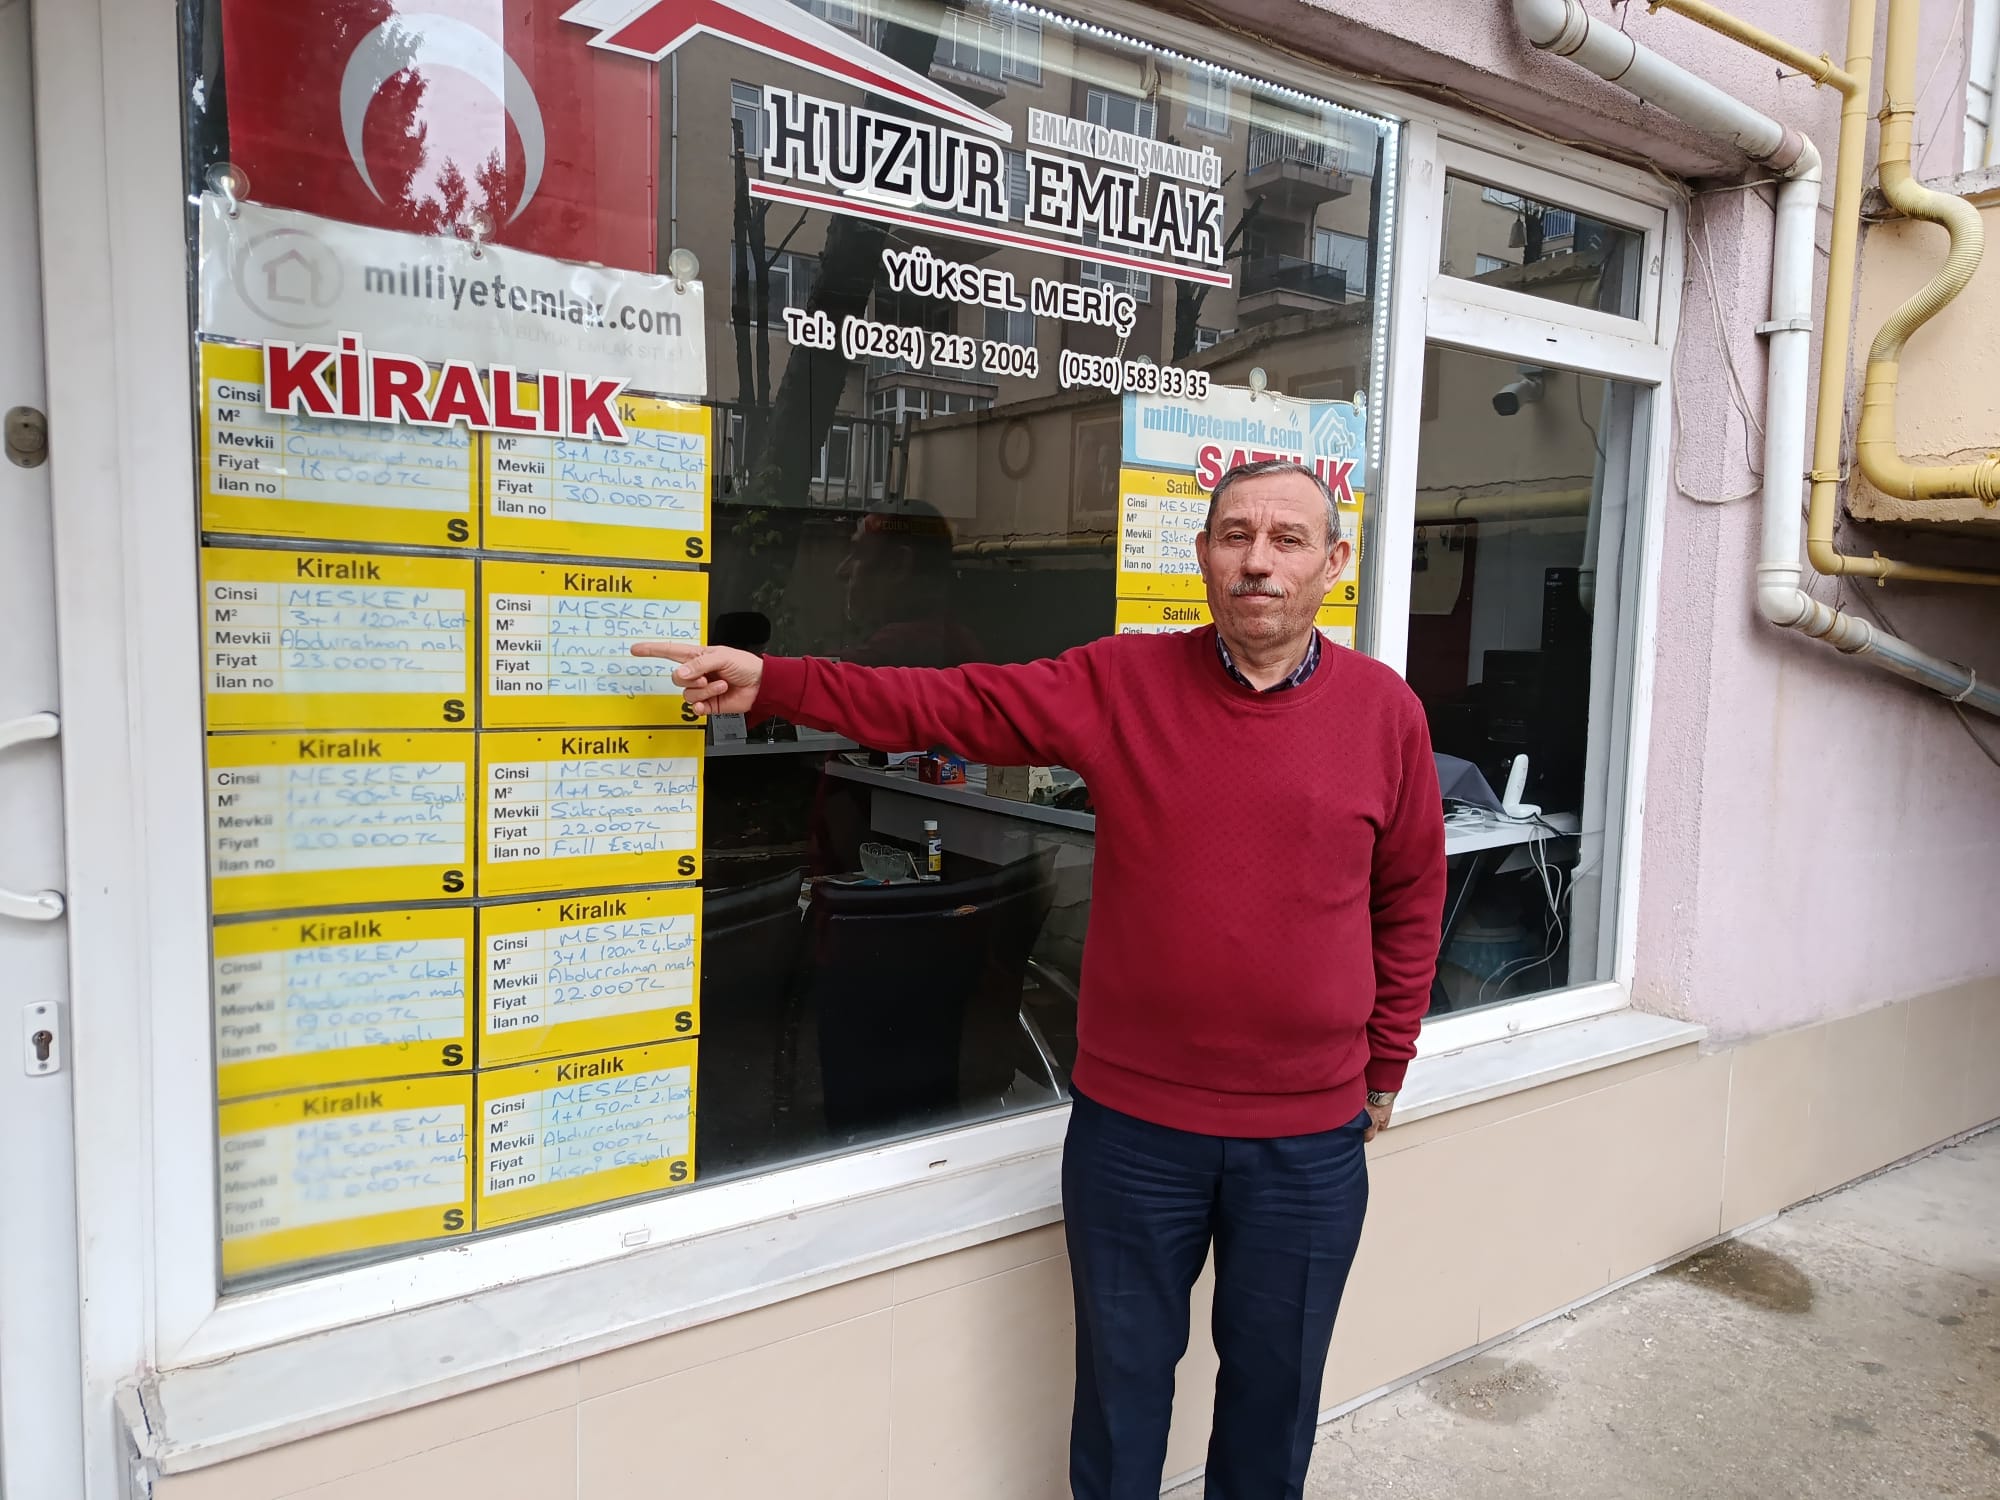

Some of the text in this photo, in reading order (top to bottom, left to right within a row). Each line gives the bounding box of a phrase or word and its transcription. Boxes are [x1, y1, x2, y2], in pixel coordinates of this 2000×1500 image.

[1032, 112, 1220, 185] EMLAK DANIŞMANLIĞI
[770, 93, 1219, 258] HUZUR EMLAK
[885, 252, 1135, 332] YÜKSEL MERİÇ
[365, 264, 683, 337] milliyetemlak.com
[788, 312, 1036, 374] Tel: (0284) 213 2004
[1063, 350, 1207, 396] (0530) 583 33 35
[217, 386, 261, 402] Cinsi
[268, 336, 621, 439] KİRALIK
[1143, 406, 1303, 449] milliyetemlak.com
[217, 432, 274, 449] Mevkii
[497, 439, 517, 450] M²
[217, 455, 260, 471] Fiyat
[497, 459, 545, 474] Mevkii
[217, 477, 276, 494] İlan no
[497, 480, 533, 494] Fiyat
[652, 474, 696, 490] mah
[497, 498, 546, 514] İlan no
[1127, 498, 1147, 507] Cinsi
[1160, 502, 1206, 514] MESKE
[447, 519, 469, 542] S
[1126, 529, 1151, 539] Mevkii
[685, 537, 703, 558] S
[1125, 544, 1144, 555] Fiyat
[297, 558, 381, 580] Kiralık
[1125, 558, 1139, 569] İlan
[564, 573, 632, 593] Kiralık
[215, 587, 257, 601] Cinsi
[288, 590, 429, 609] MESKEN
[1345, 586, 1355, 600] S
[496, 599, 531, 612] Cinsi
[558, 600, 681, 619] MESKEN
[1163, 607, 1200, 620] Satılık
[215, 610, 238, 622] M²
[496, 619, 515, 630] M²
[215, 632, 271, 645] Mevkii
[496, 640, 541, 652] Mevkii
[216, 654, 257, 668] Fiyat
[496, 660, 530, 673] Fiyat
[216, 674, 274, 688] İlan no
[496, 679, 543, 691] İlan no
[443, 699, 465, 722] S
[299, 739, 382, 759] Kiralık
[561, 737, 630, 754] Kiralık
[289, 764, 441, 786] MESKEN
[494, 767, 529, 779] Cinsi
[561, 761, 672, 778] MESKEN
[494, 787, 512, 799] M²
[494, 806, 539, 819] Mevkii
[494, 827, 527, 840] Fiyat
[494, 845, 540, 859] İlan no
[254, 859, 275, 870] no
[677, 855, 695, 876] S
[442, 870, 464, 893] S
[559, 900, 627, 921] Kiralık
[300, 920, 382, 943] Kiralık
[559, 918, 675, 946] MESKEN
[493, 937, 528, 951] Cinsi
[493, 958, 512, 970] M²
[665, 956, 695, 970] mah
[493, 974, 538, 990] Mevkii
[493, 995, 527, 1010] Fiyat
[493, 1014, 539, 1029] İlan no
[675, 1011, 693, 1032] S
[442, 1044, 463, 1067] S
[557, 1057, 624, 1081] Kiralık
[552, 1073, 670, 1108] MESKEN
[303, 1091, 383, 1116] Kiralık
[491, 1099, 525, 1115] Cinsi
[491, 1120, 508, 1134] M²
[490, 1135, 534, 1153] Mevkii
[490, 1156, 523, 1172] Fiyat
[669, 1161, 687, 1181] S
[490, 1173, 535, 1191] İlan no
[443, 1209, 465, 1231] S
